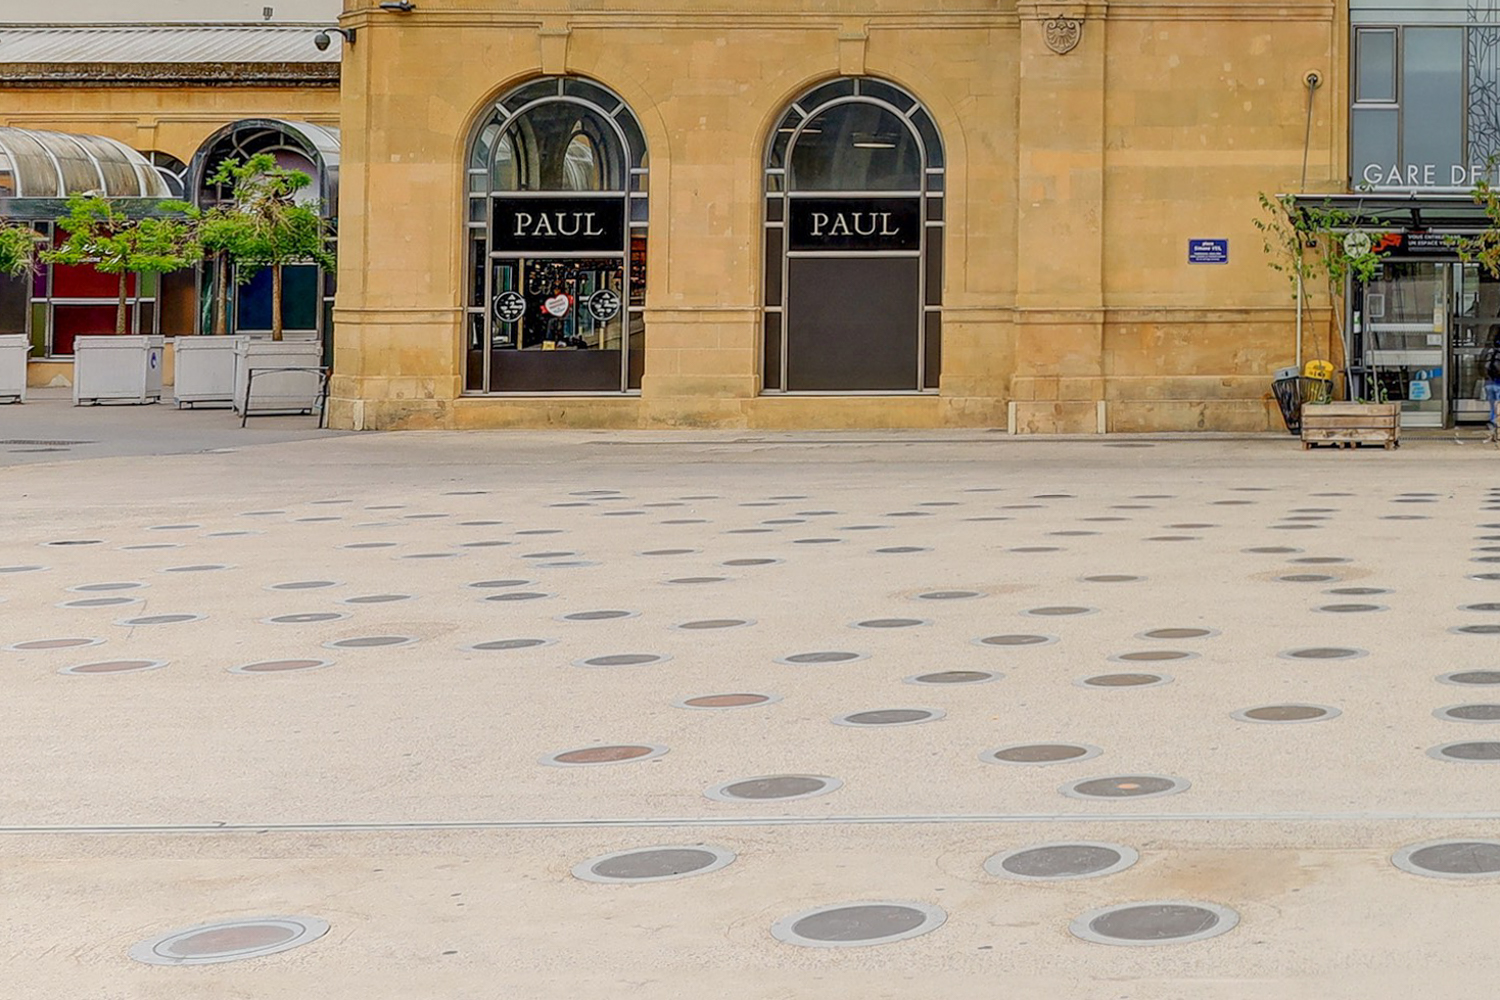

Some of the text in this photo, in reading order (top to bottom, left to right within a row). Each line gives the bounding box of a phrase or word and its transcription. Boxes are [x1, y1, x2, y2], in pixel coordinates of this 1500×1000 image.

[1363, 164, 1436, 185] GARE
[513, 212, 604, 236] PAUL
[810, 212, 900, 236] PAUL
